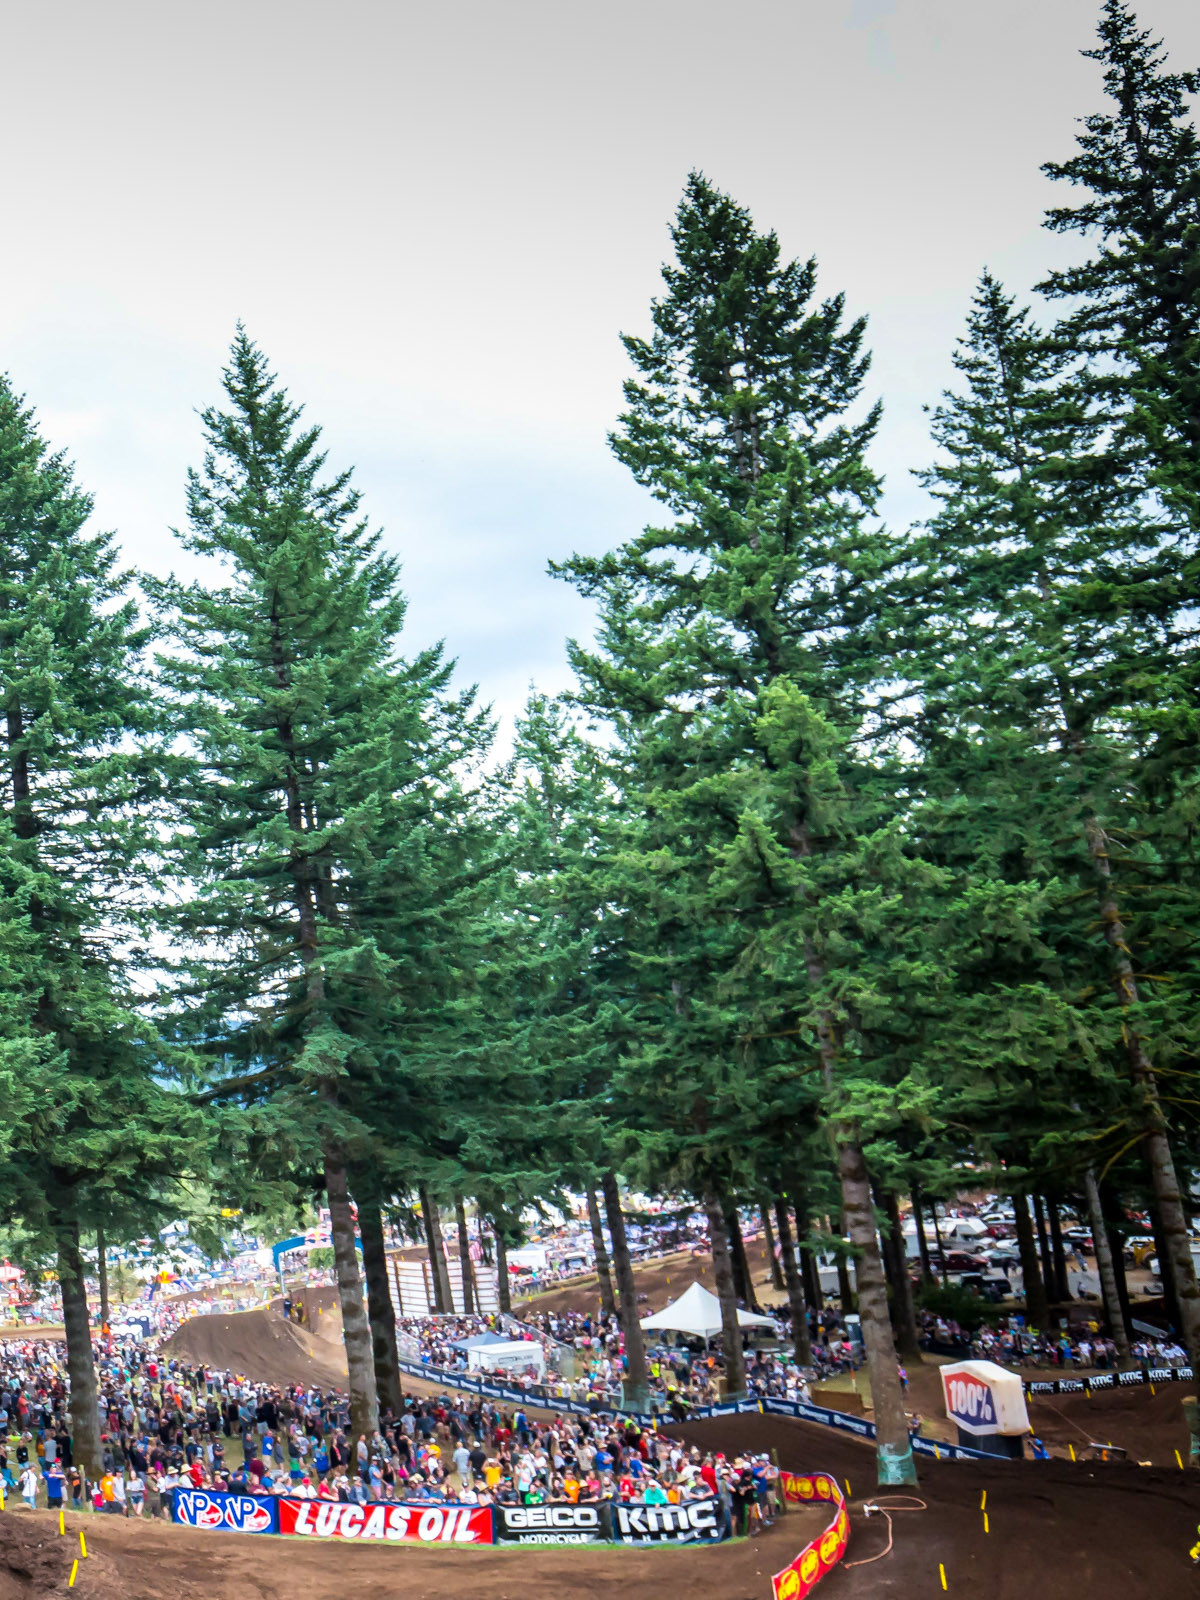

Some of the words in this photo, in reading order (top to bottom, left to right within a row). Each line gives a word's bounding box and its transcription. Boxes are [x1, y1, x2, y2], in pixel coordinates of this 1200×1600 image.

[949, 1379, 992, 1420] 100%
[179, 1492, 211, 1526] VP
[225, 1496, 258, 1530] VP
[294, 1503, 411, 1540] LUCAS
[418, 1508, 475, 1541] OIL
[504, 1507, 598, 1527] GEICO
[617, 1500, 717, 1533] KMC
[519, 1533, 588, 1545] MOTORCYCLE
